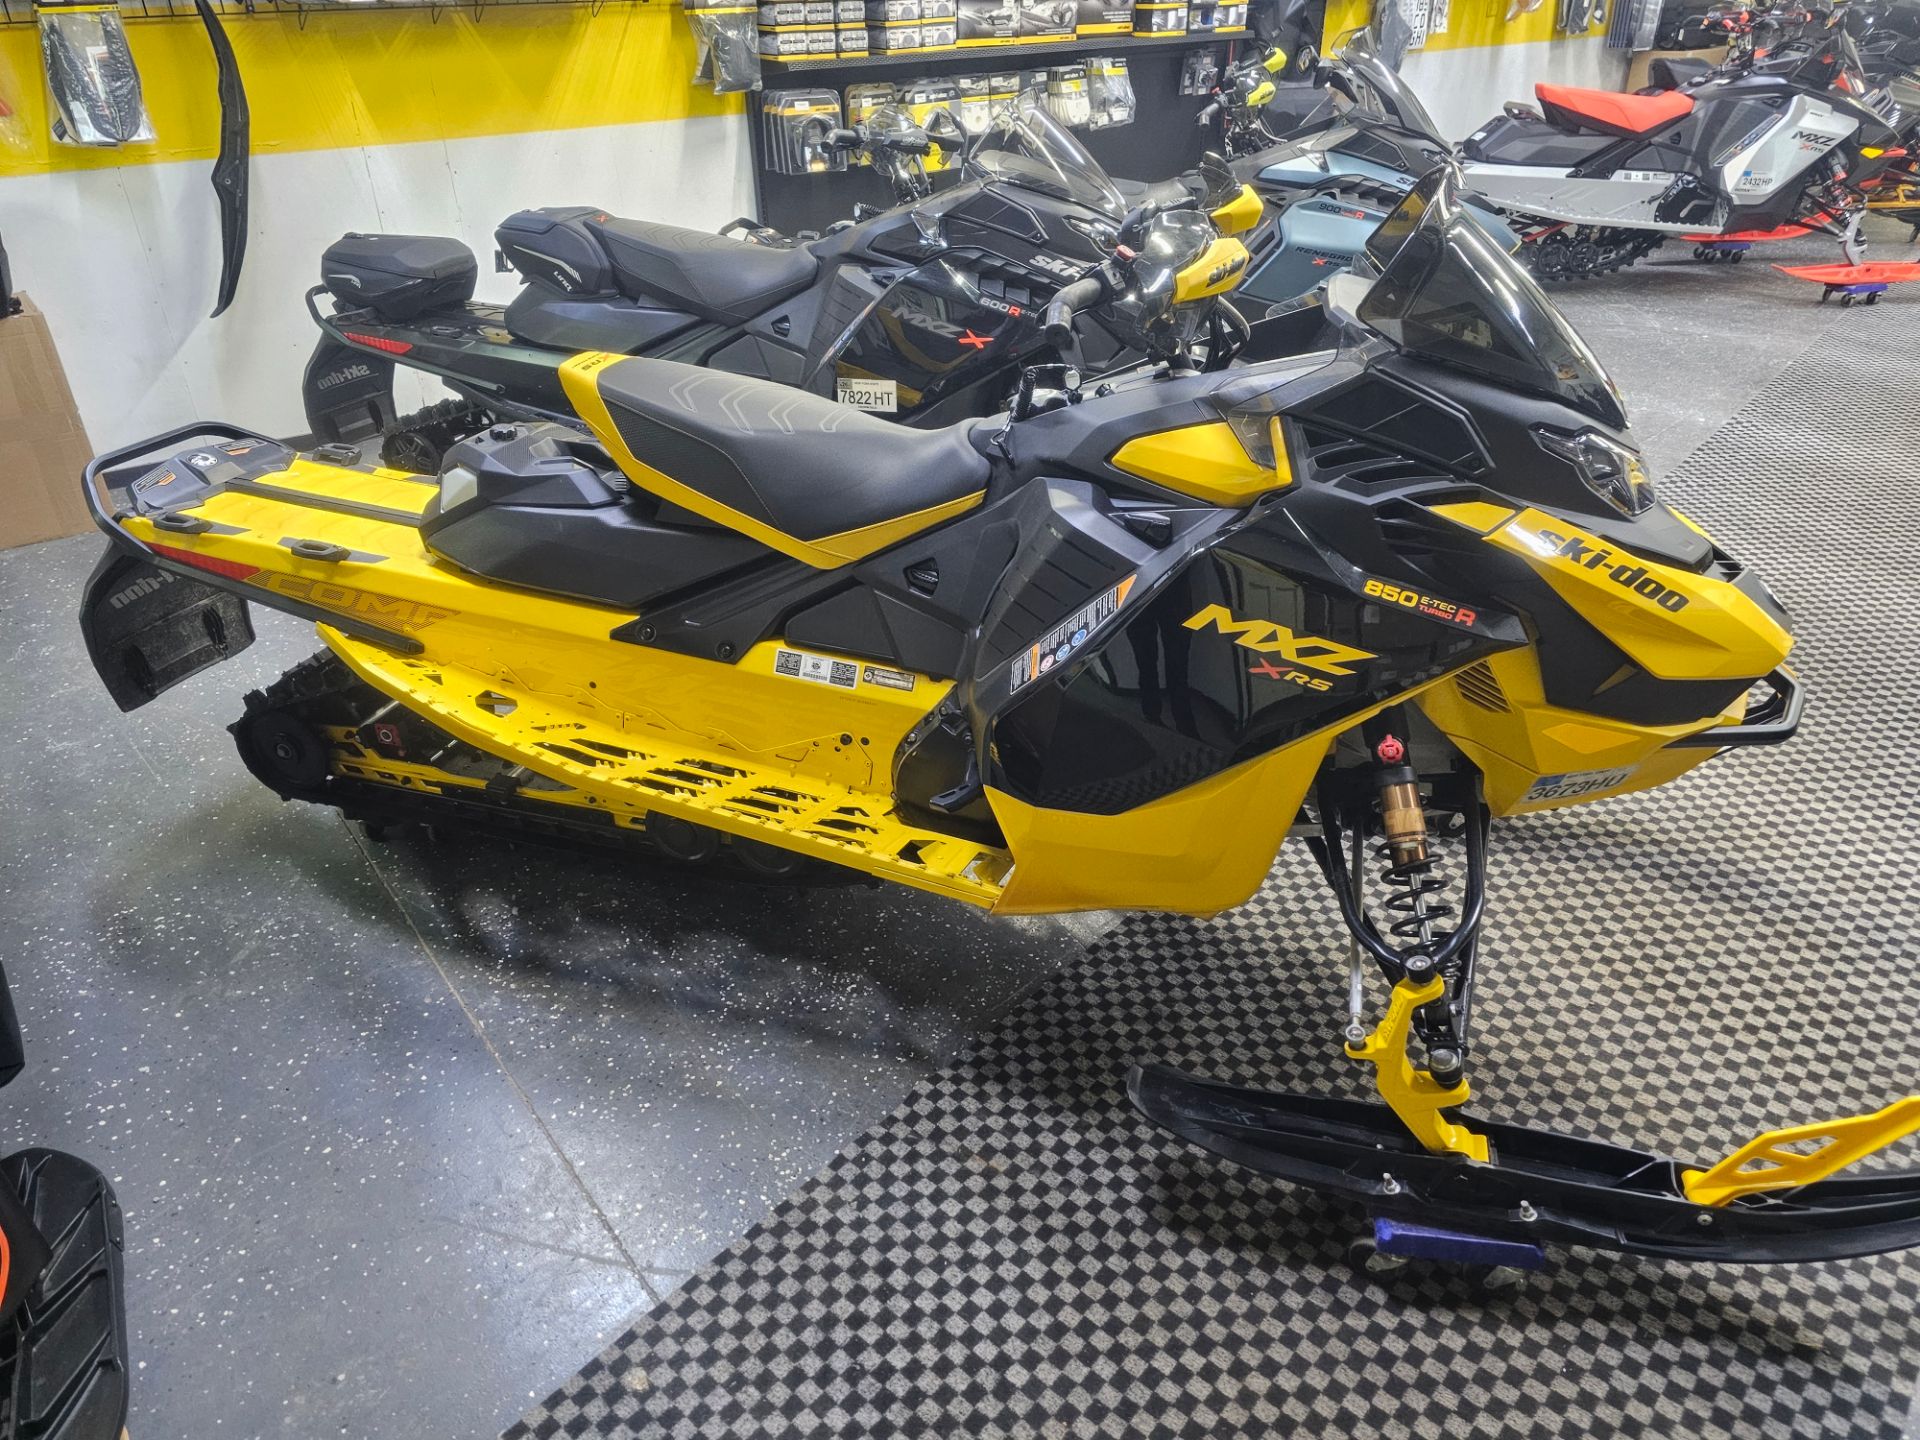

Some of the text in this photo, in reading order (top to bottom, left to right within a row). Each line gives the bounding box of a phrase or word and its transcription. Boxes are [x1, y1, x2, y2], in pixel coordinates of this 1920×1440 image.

[1791, 130, 1836, 147] MXZ
[1319, 202, 1342, 214] 900
[1296, 246, 1353, 262] RENEGAD
[1029, 255, 1081, 281] ski-
[891, 307, 994, 349] MXZ X
[840, 390, 893, 406] 7822 HT
[1537, 530, 1690, 613] ski-doo
[1363, 579, 1476, 627] 850 E-TEC R
[1419, 604, 1453, 620] TURBO
[1181, 603, 1379, 676] MXZ
